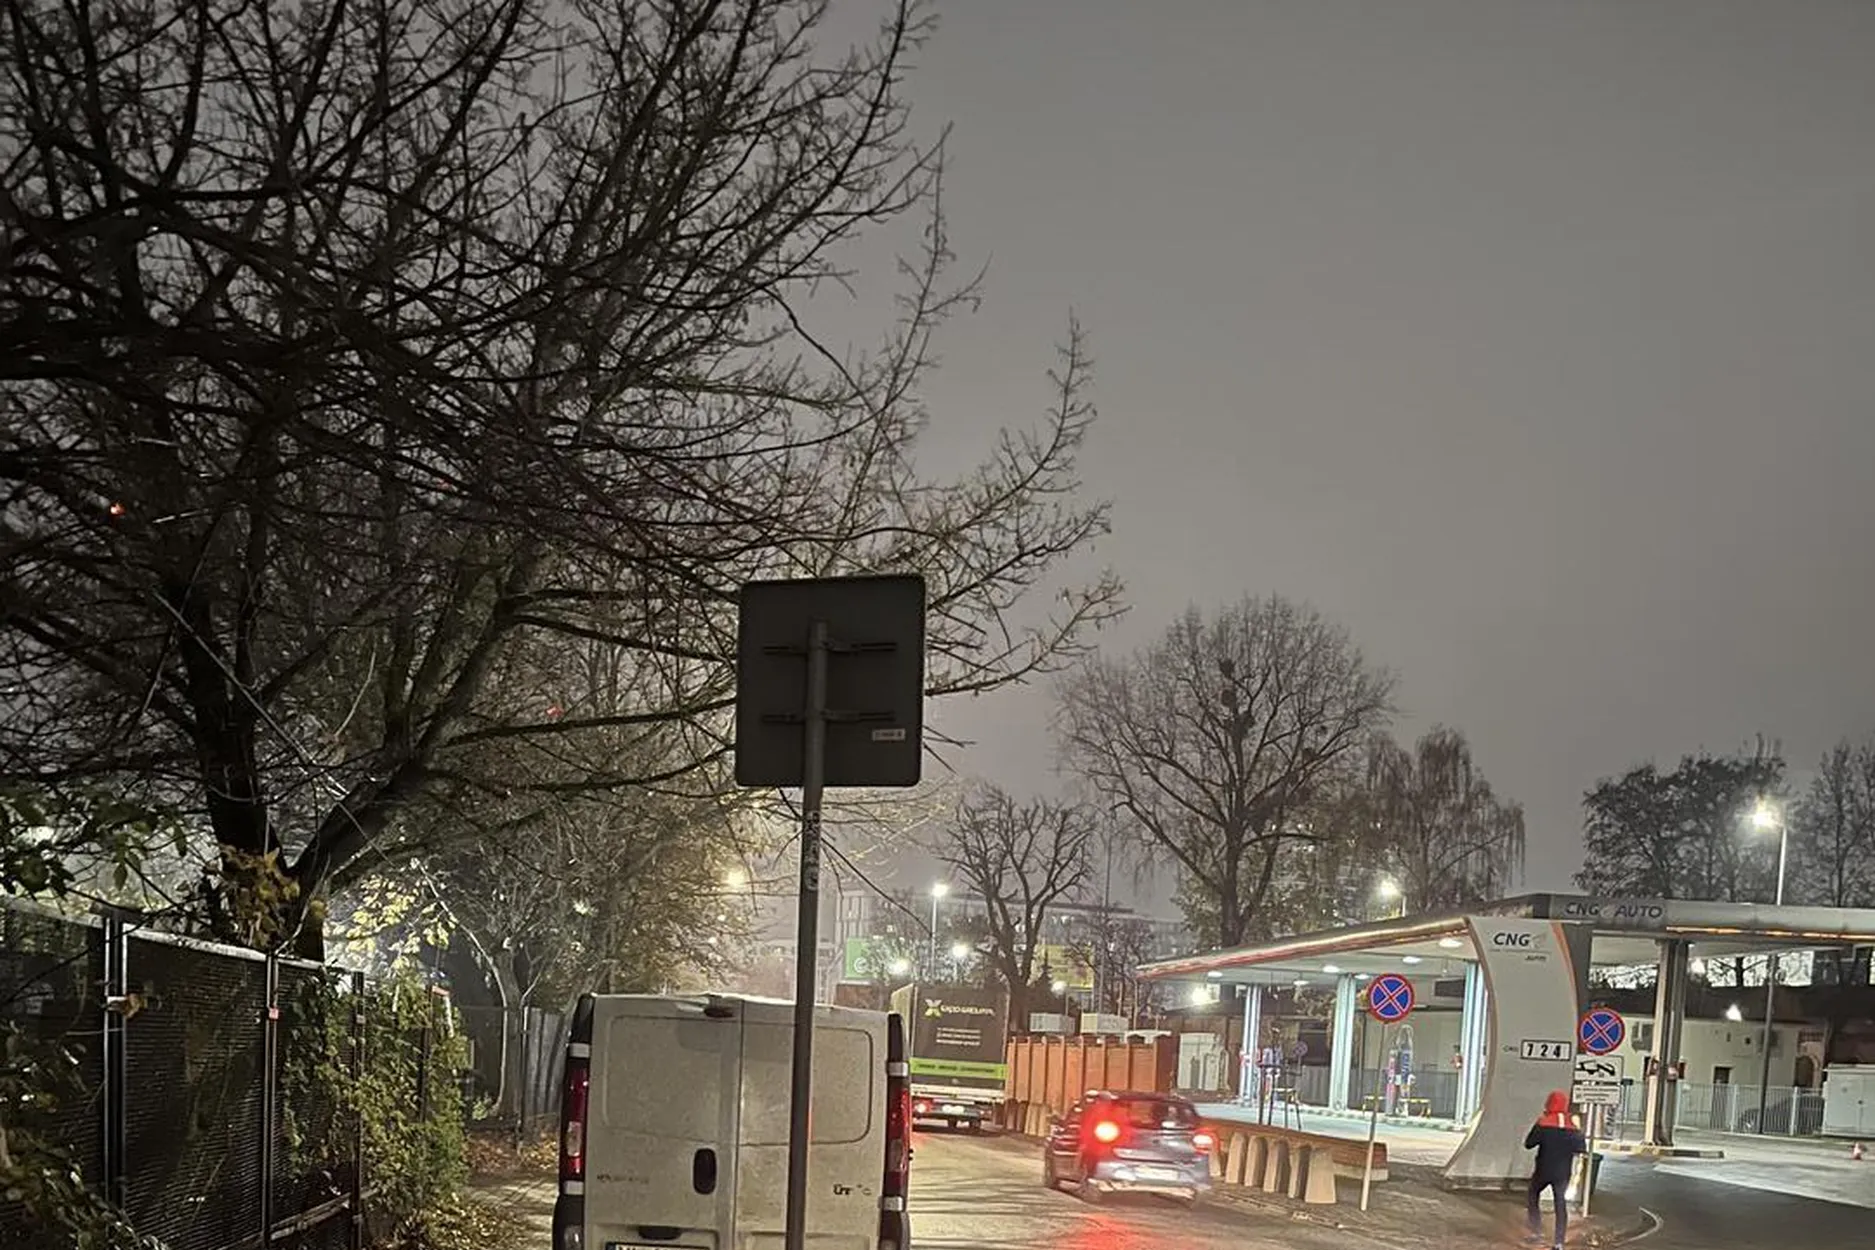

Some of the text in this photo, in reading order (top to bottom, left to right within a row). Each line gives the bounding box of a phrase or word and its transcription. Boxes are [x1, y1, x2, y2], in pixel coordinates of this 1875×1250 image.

[1565, 902, 1663, 918] CNG AUTO
[1493, 933, 1531, 947] CNG
